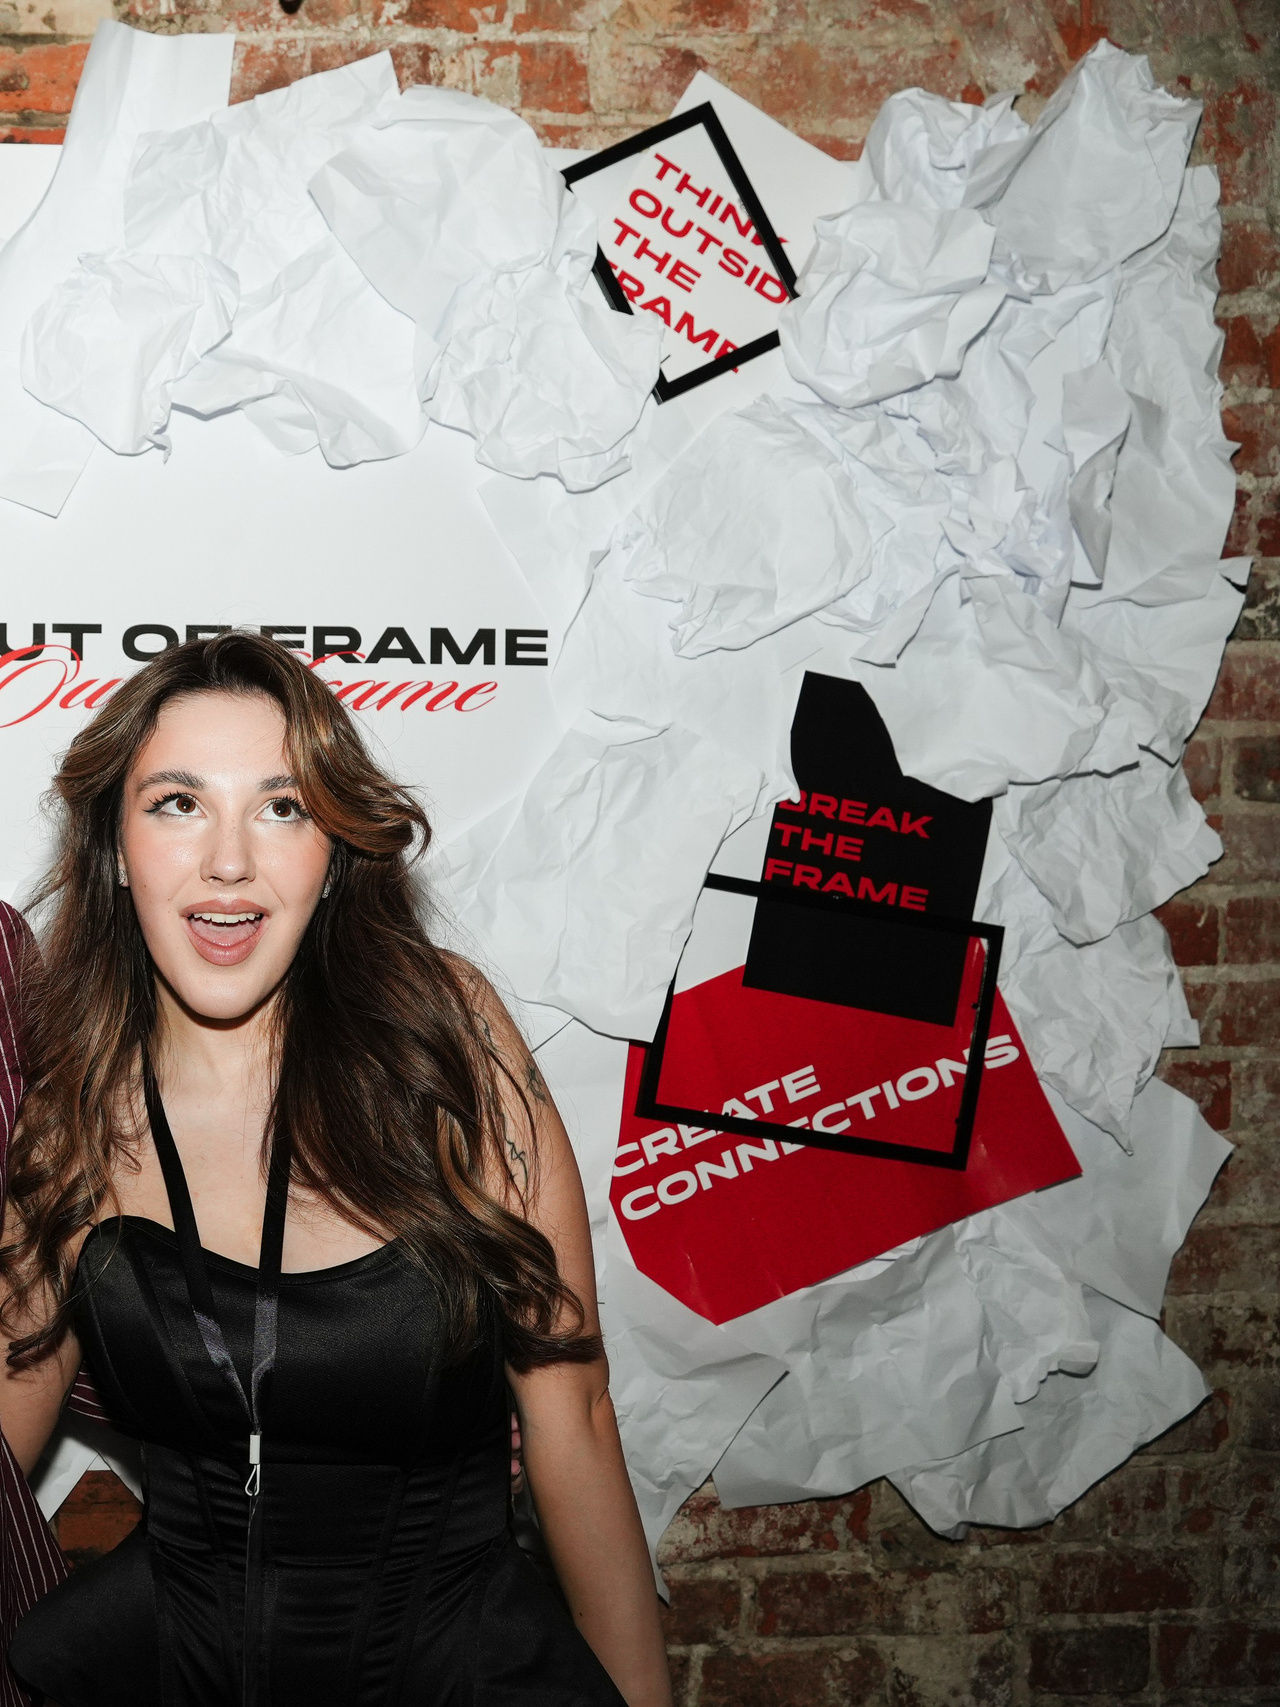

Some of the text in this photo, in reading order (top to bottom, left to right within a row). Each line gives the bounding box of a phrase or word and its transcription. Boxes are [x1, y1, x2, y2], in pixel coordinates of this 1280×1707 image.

[613, 218, 702, 293] THE
[628, 188, 791, 304] OUTSID
[607, 259, 739, 373] RAM
[260, 626, 549, 667] FRAME
[307, 650, 498, 712] ame
[774, 821, 865, 862] THE
[764, 857, 930, 912] FRAME
[612, 1064, 821, 1177] CREATE
